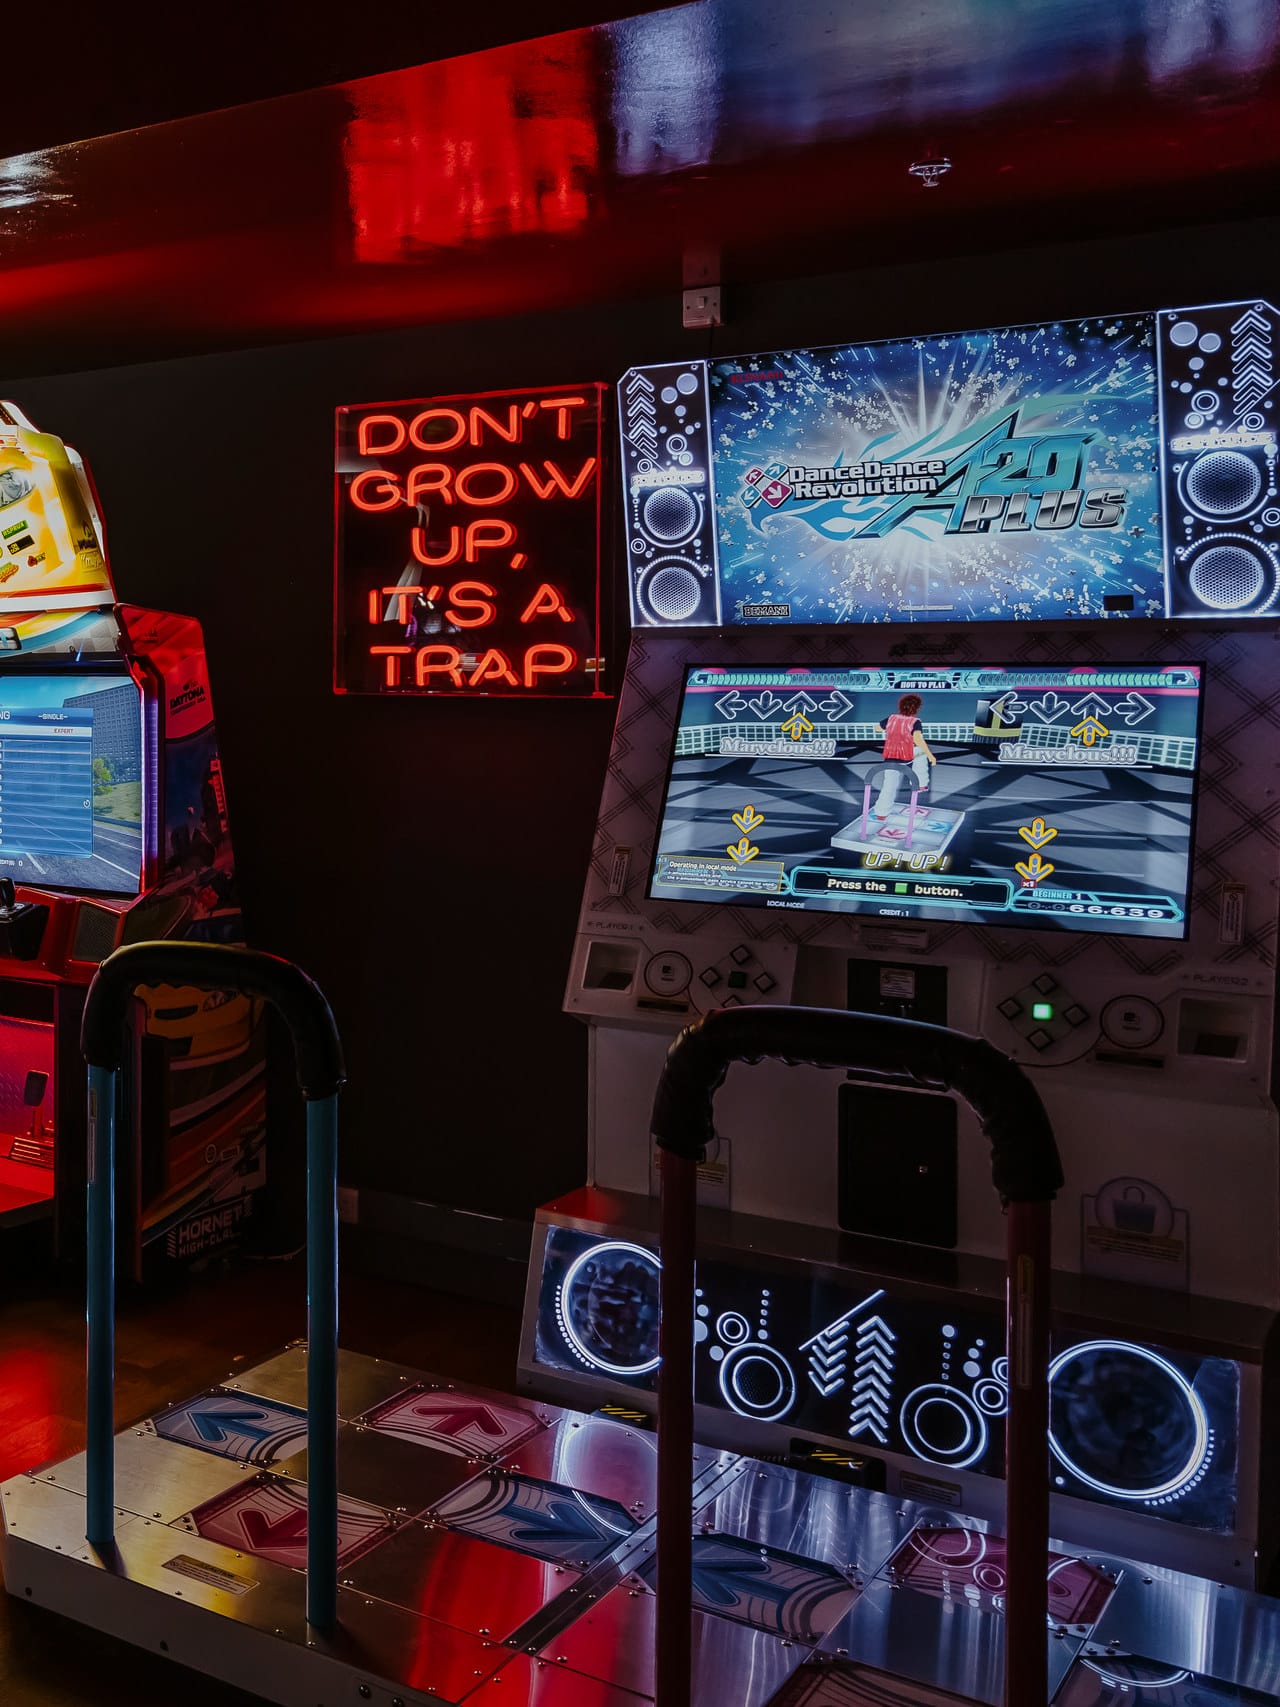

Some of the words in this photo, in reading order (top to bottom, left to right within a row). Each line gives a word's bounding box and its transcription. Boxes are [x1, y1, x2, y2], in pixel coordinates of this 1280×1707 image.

[358, 396, 585, 456] DON'T
[789, 459, 945, 484] DanceDance
[350, 457, 597, 512] GROW
[794, 476, 939, 499] Revolution
[957, 487, 1130, 533] PLUS
[411, 519, 528, 570] UP,
[368, 580, 497, 629] IT'S
[520, 583, 576, 623] A
[743, 605, 790, 617] BEMANI
[369, 643, 578, 688] TRAP
[720, 737, 837, 757] Marvelous!!!
[999, 743, 1139, 765] Marvelous!!!
[669, 861, 698, 870] Operating
[827, 878, 862, 891] Press
[865, 880, 887, 892] the
[915, 884, 964, 897] button.
[1032, 889, 1072, 899] BEGINNER
[788, 901, 805, 909] MODE
